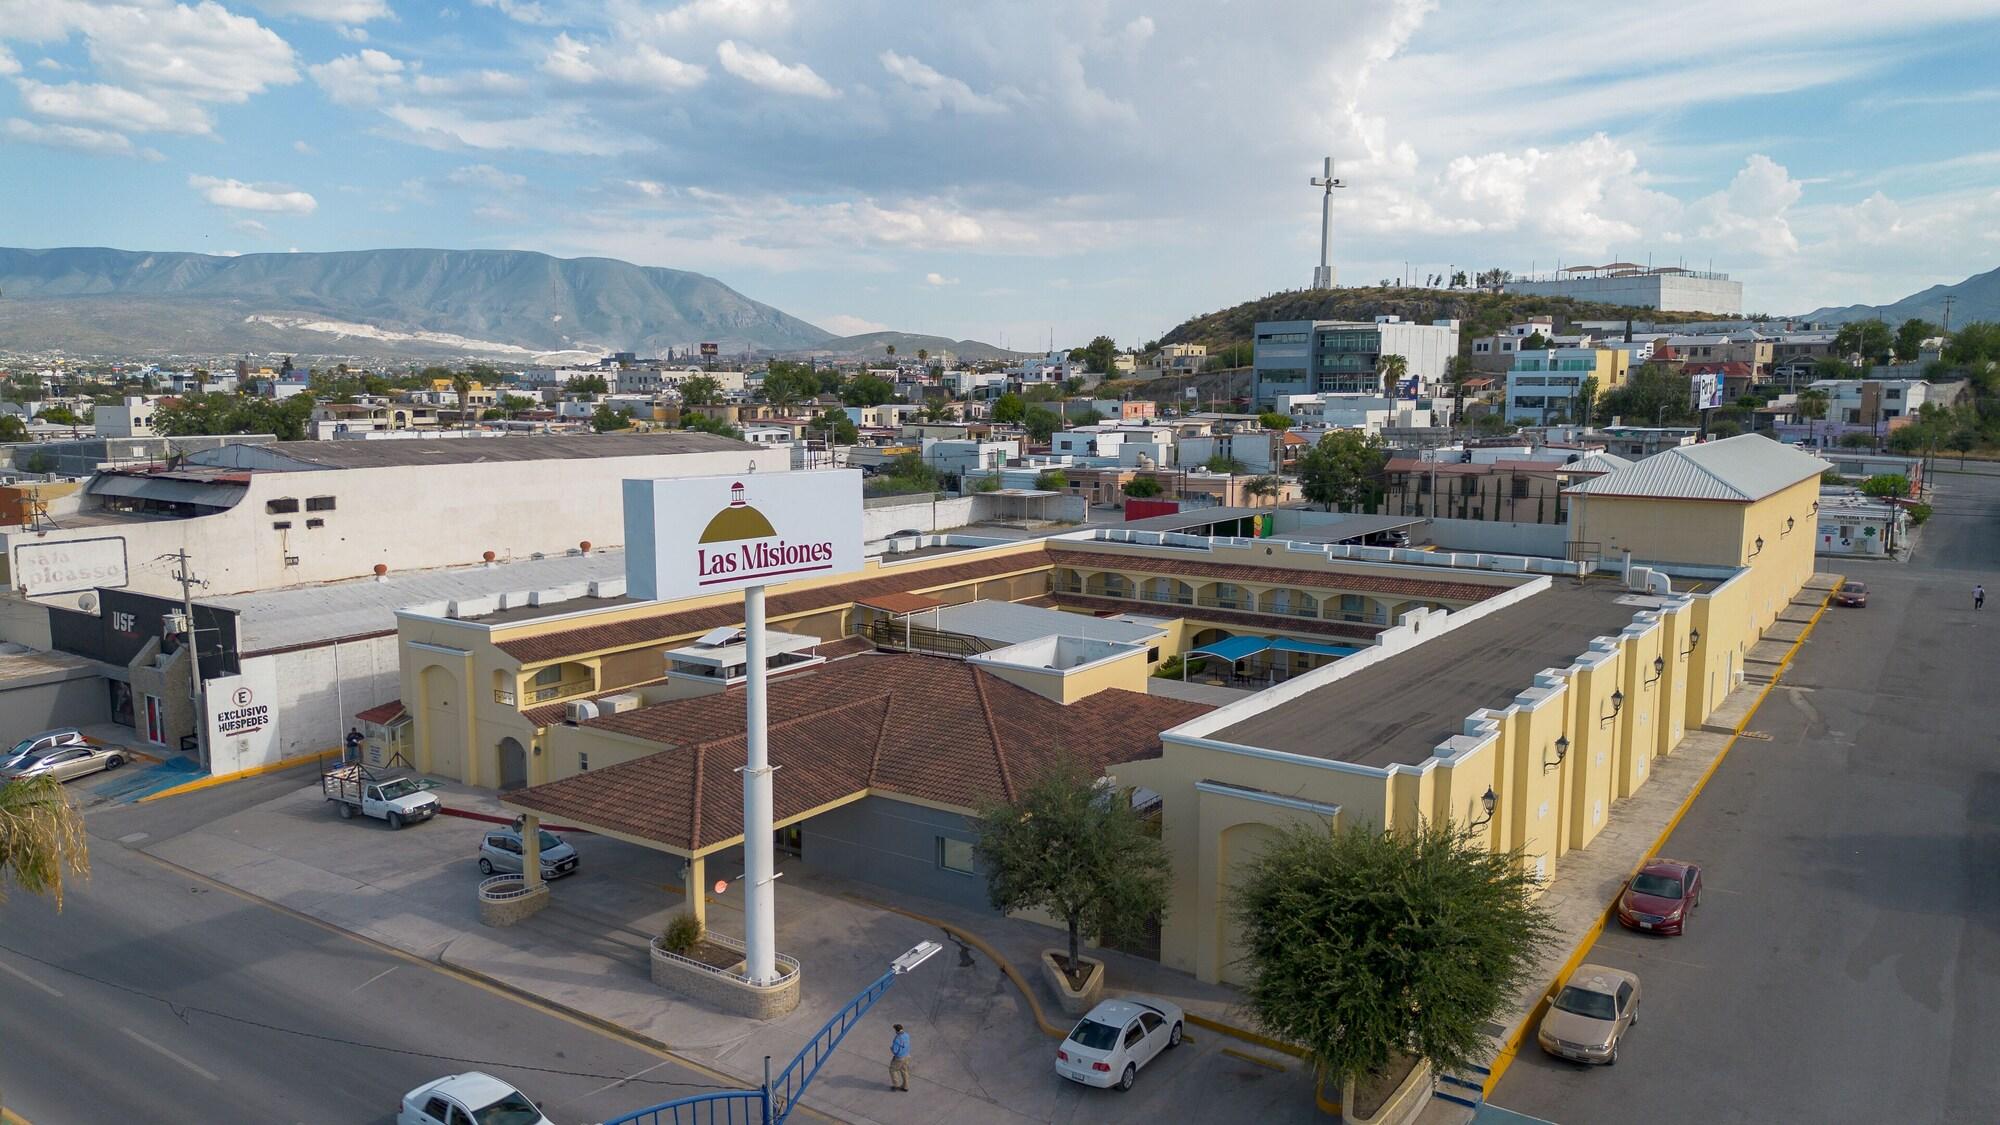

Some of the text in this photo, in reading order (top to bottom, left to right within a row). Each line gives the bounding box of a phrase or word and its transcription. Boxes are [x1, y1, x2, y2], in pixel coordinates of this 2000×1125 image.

[698, 540, 833, 577] Las Misiones
[30, 565, 119, 588] picasso
[112, 611, 136, 633] USF
[238, 691, 247, 703] E
[217, 705, 268, 722] EXCLUSIVO
[218, 715, 269, 732] HUESPEDES
